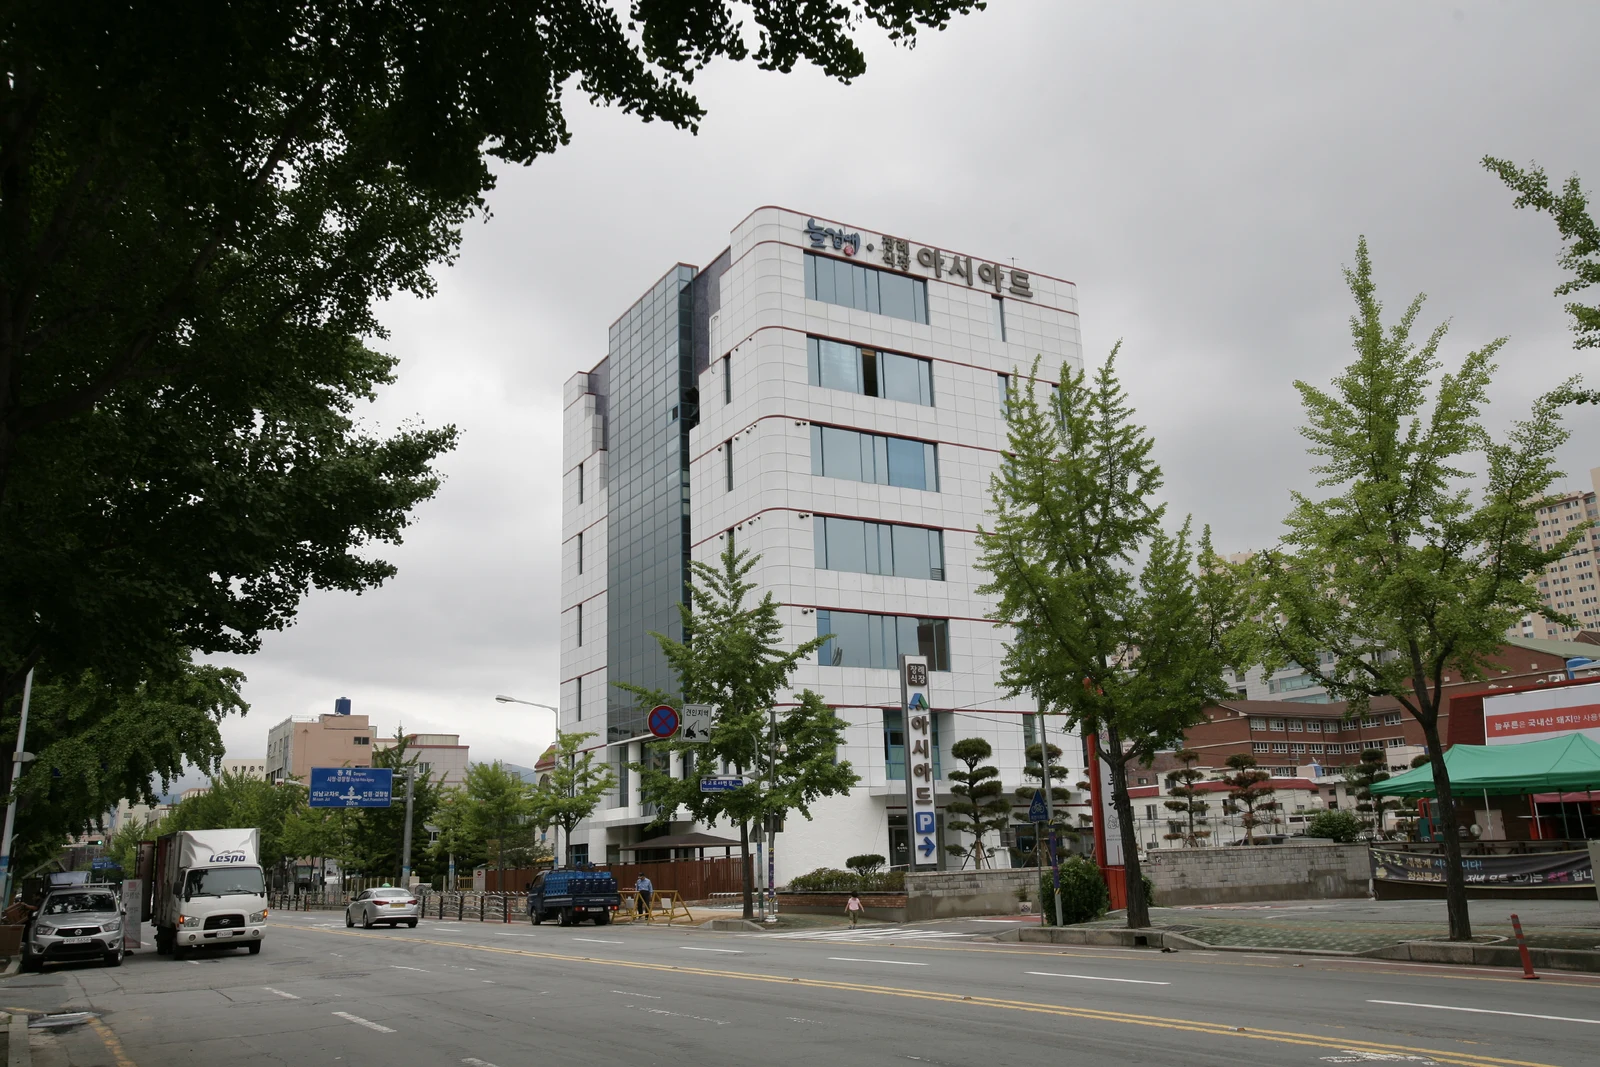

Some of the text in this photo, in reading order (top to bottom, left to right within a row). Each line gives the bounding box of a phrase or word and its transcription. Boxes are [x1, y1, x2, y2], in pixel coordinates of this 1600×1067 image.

[917, 247, 1033, 298] 아시아드
[685, 708, 709, 717] 견인지역
[1494, 720, 1526, 731] 늘푸른은
[1528, 716, 1554, 727] 국내산
[1556, 714, 1581, 724] 돼지만
[911, 715, 933, 805] 아시아드
[919, 814, 932, 831] P
[209, 854, 246, 863] Lespo
[1572, 868, 1594, 881] 합니
